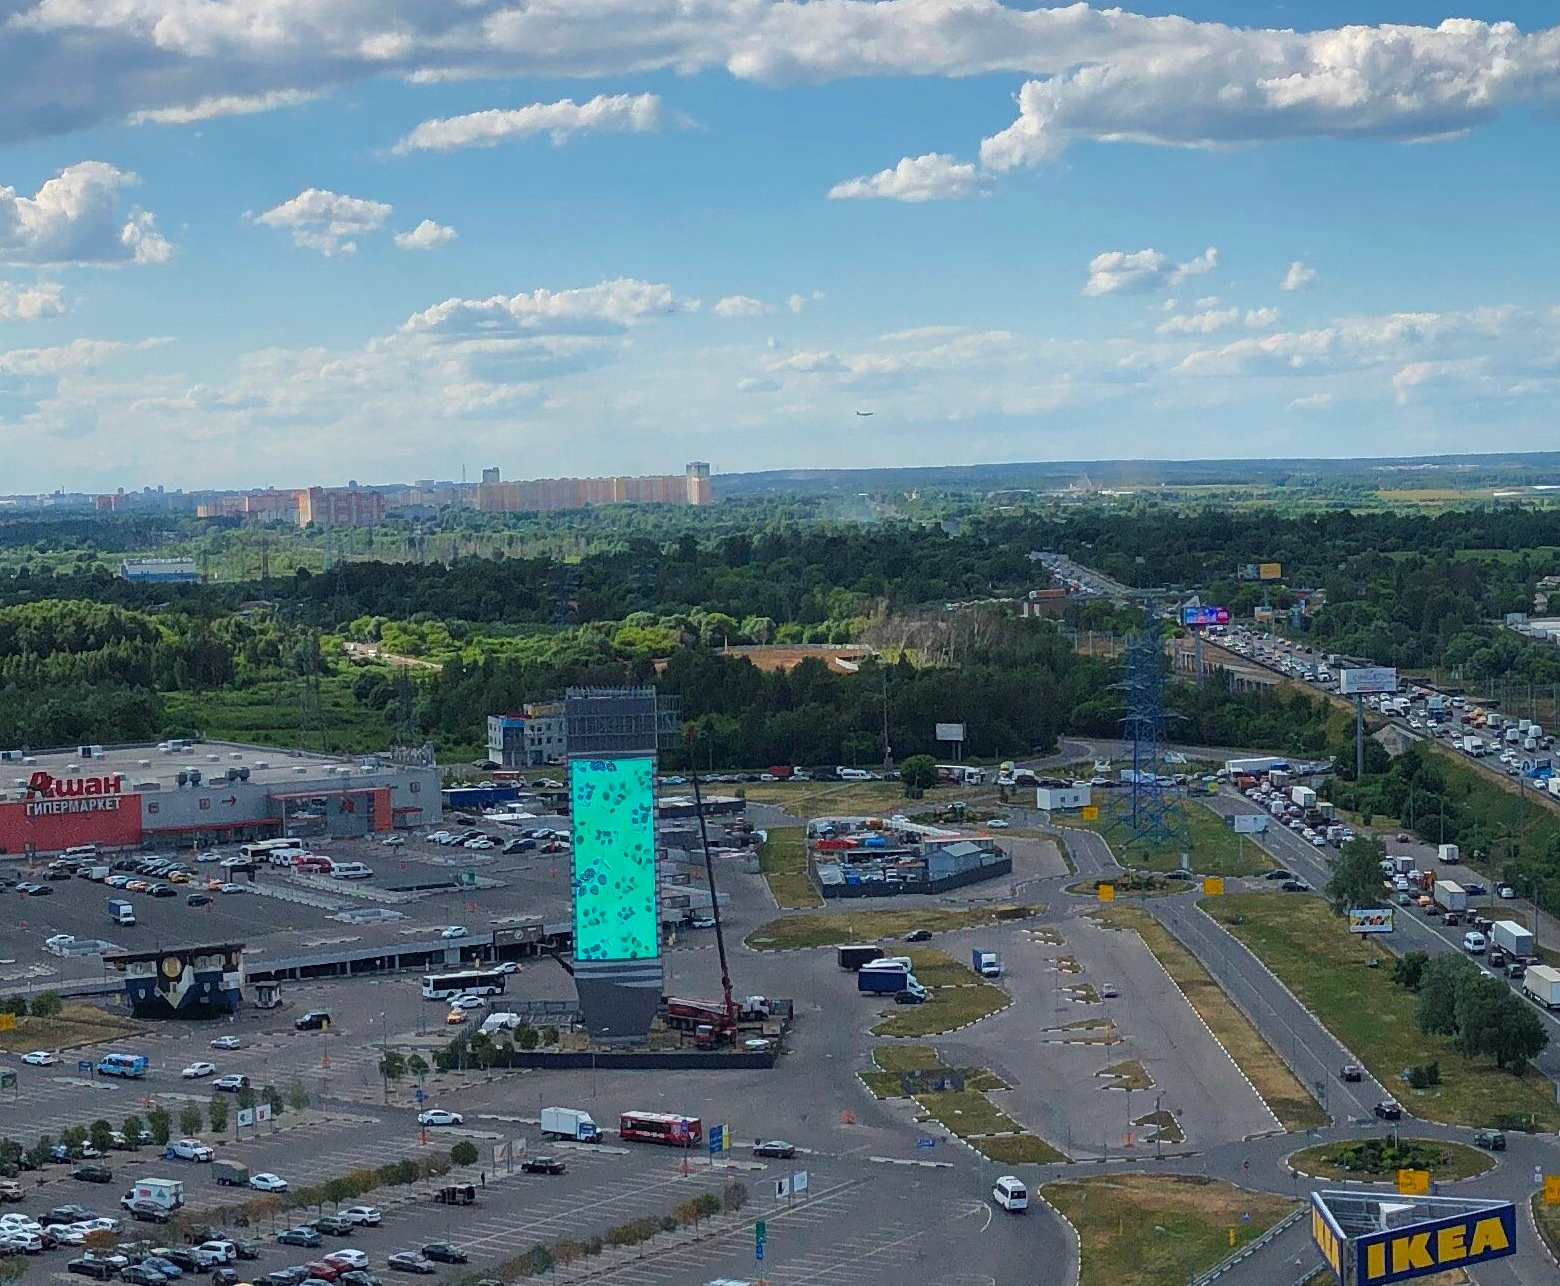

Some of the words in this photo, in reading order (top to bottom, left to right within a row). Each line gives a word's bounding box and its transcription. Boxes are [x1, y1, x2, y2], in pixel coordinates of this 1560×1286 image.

[26, 772, 122, 799] Ашан
[27, 797, 121, 816] ГИПЕРМАРКЕТ
[1367, 1217, 1509, 1280] IKEA
